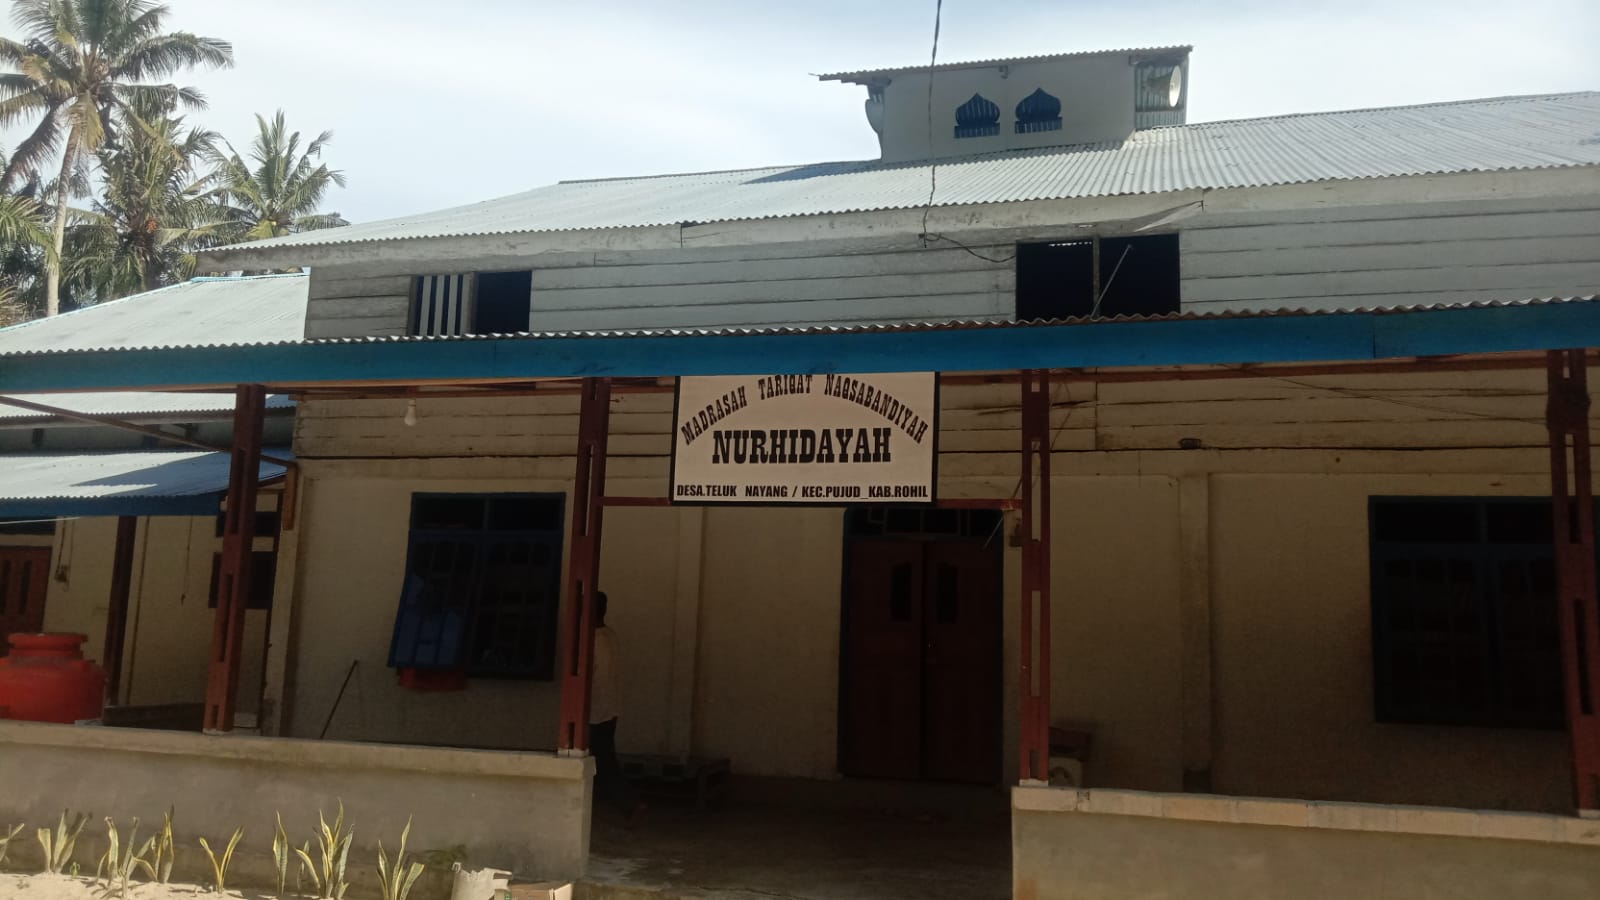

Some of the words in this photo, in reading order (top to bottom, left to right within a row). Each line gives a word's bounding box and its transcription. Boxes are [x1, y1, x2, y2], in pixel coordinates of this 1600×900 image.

[681, 385, 748, 446] MADRASAH
[758, 374, 813, 401] TARIQAT
[824, 373, 929, 444] NAQSABANDIYAH
[712, 427, 892, 465] NURHIDAYAH
[676, 485, 737, 497] DESA.TELUK
[745, 485, 788, 498] NAYANG
[792, 486, 798, 498] /
